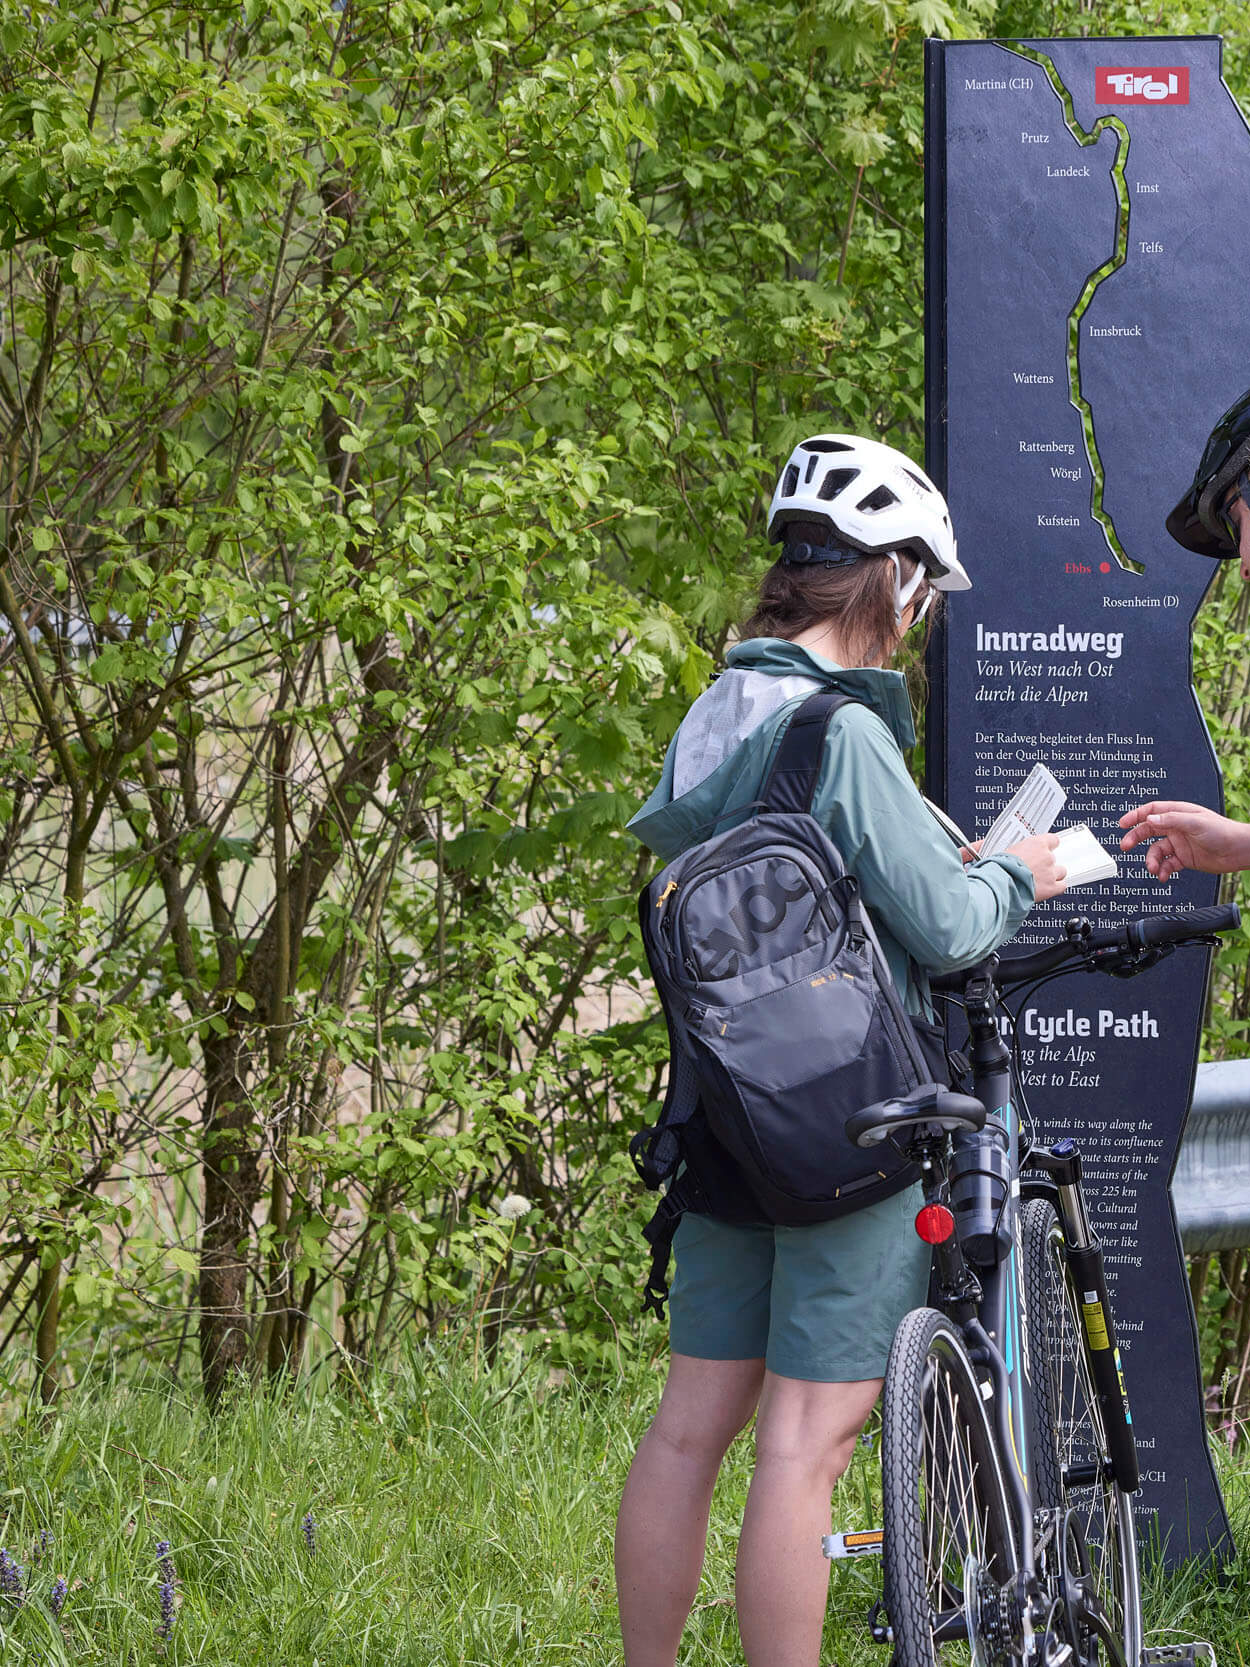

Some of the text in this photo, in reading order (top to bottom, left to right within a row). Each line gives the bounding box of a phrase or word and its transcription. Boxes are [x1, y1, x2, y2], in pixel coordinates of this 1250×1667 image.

[964, 78, 1033, 91] Martina (CH)
[1107, 73, 1178, 99] Tirol
[1021, 131, 1050, 144] Prutz
[1046, 165, 1091, 177] Landeck
[1136, 181, 1160, 193] Imst
[1138, 241, 1164, 254] Telfs
[1089, 324, 1142, 337] Innsbruck
[1013, 372, 1054, 384] Wattens
[1020, 441, 1075, 455] Rattenberg
[1051, 468, 1081, 481] Wörgl
[1037, 514, 1080, 527] Kufstein
[1065, 562, 1091, 574] Ebbs
[1103, 595, 1179, 608] Rosenheim (D)
[976, 623, 1124, 659] Innradweg
[977, 660, 1114, 676] Von West nach Ost
[975, 685, 1088, 706] durch die Alpen
[975, 732, 1154, 746] Der Radweg begleitet den Fluss Inn
[974, 748, 1154, 764] von der Quelle bis zur Mündung in
[974, 765, 991, 777] die
[993, 766, 1029, 778] Donau.
[1088, 767, 1100, 778] in
[1102, 766, 1120, 778] der
[1122, 768, 1166, 780] mystisch
[975, 785, 1004, 794] rauen
[1073, 783, 1126, 795] Schweizer
[1128, 784, 1158, 797] Alpen
[975, 798, 995, 810] und
[1068, 799, 1098, 812] durch
[1100, 800, 1117, 812] die
[1099, 884, 1110, 896] In
[1114, 885, 1148, 898] Bayern
[1151, 884, 1172, 896] und
[1053, 900, 1076, 912] lässt
[1077, 903, 1089, 912] er
[1090, 900, 1107, 912] die
[1110, 901, 1138, 915] Berge
[1141, 901, 1174, 913] hinter
[1175, 902, 1196, 913] sich
[1024, 1008, 1092, 1044] Cycle
[1098, 1008, 1160, 1039] Path
[1040, 1045, 1061, 1061] the
[1064, 1046, 1095, 1066] Alps
[1052, 1074, 1064, 1086] to
[1068, 1071, 1100, 1087] East
[1043, 1117, 1072, 1129] winds
[1073, 1117, 1086, 1129] its
[1087, 1121, 1108, 1133] way
[1110, 1119, 1135, 1132] along
[1138, 1119, 1153, 1130] the
[1041, 1133, 1057, 1146] its
[1088, 1136, 1098, 1146] to
[1100, 1135, 1112, 1146] its
[1114, 1136, 1163, 1149] confluence
[1081, 1152, 1160, 1164] oute starts in the
[1082, 1169, 1121, 1181] untains
[1122, 1169, 1132, 1182] of
[1133, 1169, 1149, 1181] the
[1101, 1185, 1120, 1197] 225
[1121, 1185, 1137, 1197] km
[1097, 1201, 1138, 1214] Cultural
[1119, 1219, 1139, 1231] and
[1120, 1235, 1139, 1248] like
[1104, 1253, 1143, 1268] rmitting
[1113, 1320, 1144, 1331] behind
